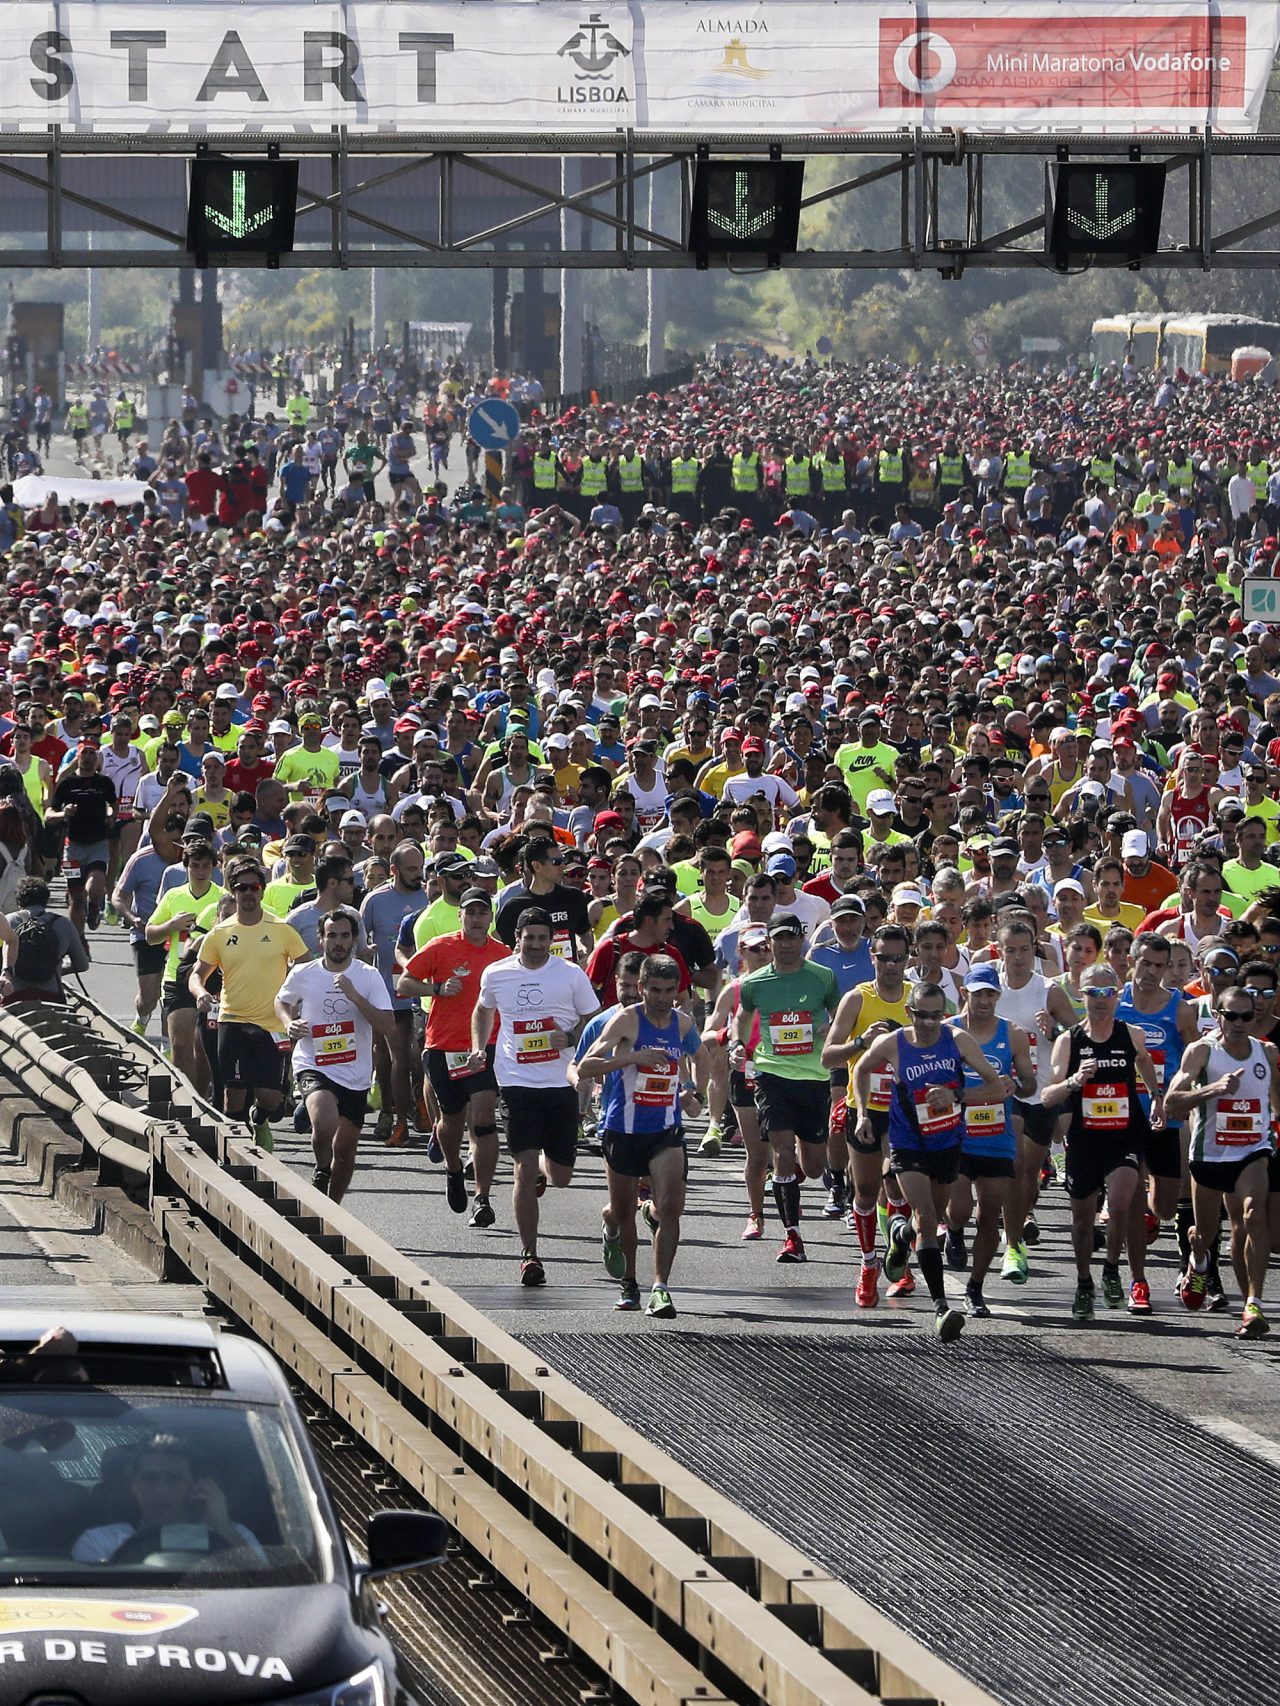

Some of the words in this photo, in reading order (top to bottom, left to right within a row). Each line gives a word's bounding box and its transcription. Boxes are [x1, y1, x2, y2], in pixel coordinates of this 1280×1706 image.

[696, 19, 770, 33] ALMADA
[986, 53, 1028, 72] Mini
[1032, 54, 1126, 72] Maratona
[1128, 52, 1231, 71] Vodafone
[557, 86, 630, 103] LISBOA
[728, 99, 776, 108] MUNICIPAL
[854, 755, 877, 765] RUN
[517, 989, 544, 1006] SC
[323, 998, 350, 1016] SC
[782, 1012, 800, 1025] edp
[324, 1023, 342, 1035] edp
[525, 1020, 543, 1032] edp
[783, 1031, 799, 1040] 292
[327, 1041, 342, 1050] 375
[528, 1039, 543, 1048] 373
[906, 1057, 956, 1082] ODIMARQ
[1096, 1086, 1116, 1099] edp
[1096, 1104, 1113, 1114] 514
[1231, 1101, 1251, 1113] edp
[974, 1112, 990, 1121] 456
[44, 1638, 107, 1665] DE
[125, 1644, 294, 1683] PROVA
